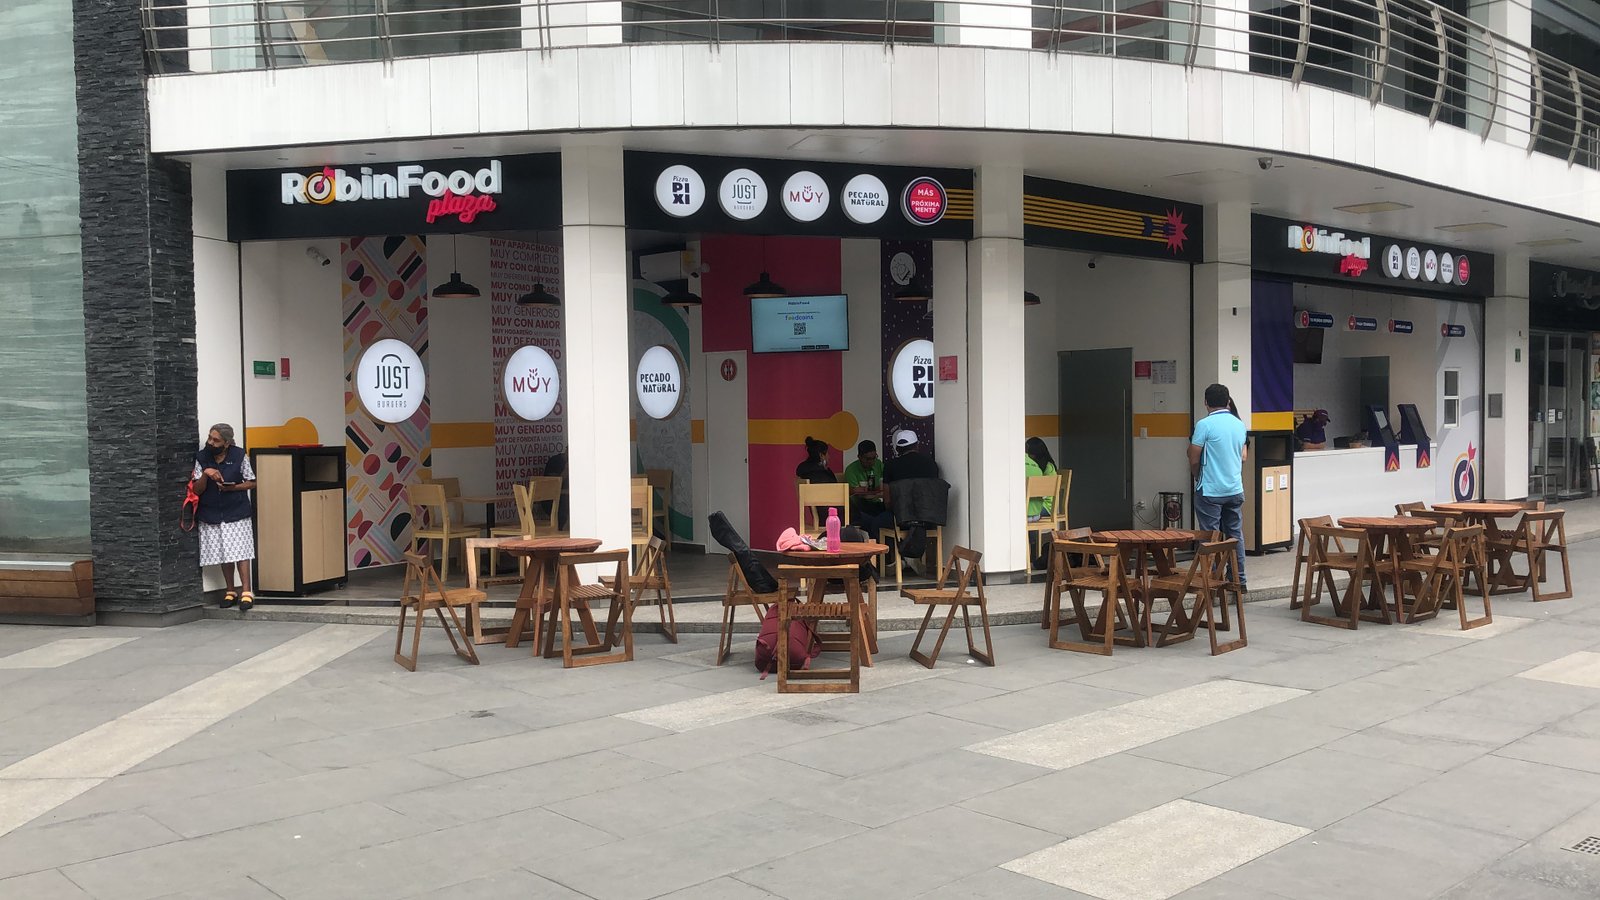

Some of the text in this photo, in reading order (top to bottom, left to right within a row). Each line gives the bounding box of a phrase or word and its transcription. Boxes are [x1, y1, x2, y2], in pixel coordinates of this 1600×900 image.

[281, 160, 502, 204] RobinFood
[672, 182, 690, 193] PI
[732, 184, 758, 200] JUST
[790, 191, 824, 203] MUY
[918, 188, 934, 196] MÁS
[672, 194, 690, 204] XI
[911, 199, 940, 208] PRÓXIMA
[426, 190, 496, 224] plaza
[490, 238, 506, 247] MUY
[490, 248, 559, 264] MUY COMPLETO
[491, 260, 559, 274] MUY CON CALIDAD
[509, 283, 530, 291] COMO
[491, 292, 513, 302] MUY
[492, 305, 560, 318] MUY GENEROSO
[492, 317, 560, 329] MUY CON AMOR
[492, 336, 560, 347] MUY DE FONDITA
[913, 356, 932, 365] Pizza
[374, 366, 410, 389] JUST
[640, 373, 670, 383] PECADO
[913, 366, 933, 381] PI
[513, 378, 551, 392] MUY
[912, 383, 933, 398] XI
[495, 425, 562, 435] MUY GENEROSO
[496, 442, 563, 456] MUY VARIADO
[496, 458, 516, 468] MUY
[496, 469, 518, 480] MUY
[497, 509, 516, 521] MUY
